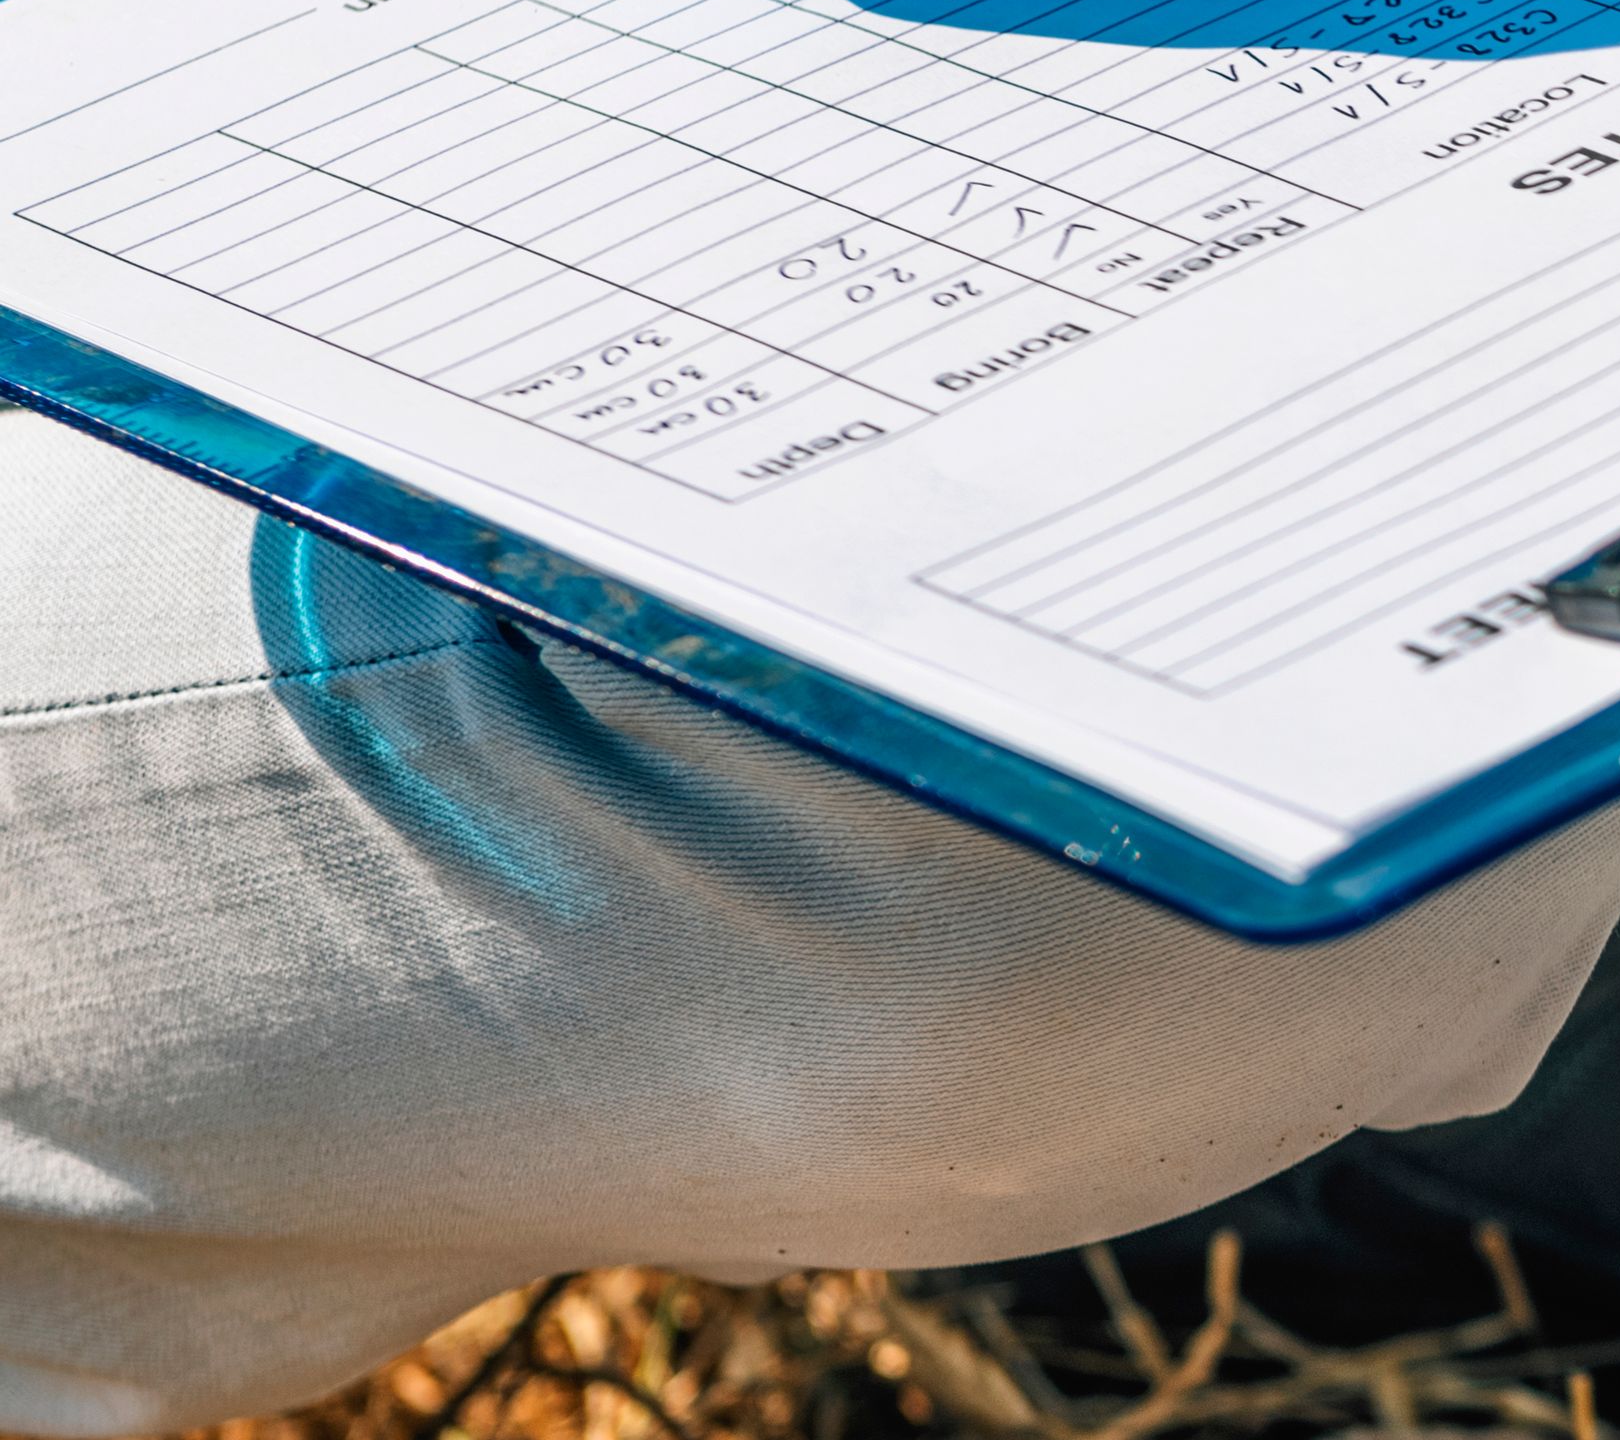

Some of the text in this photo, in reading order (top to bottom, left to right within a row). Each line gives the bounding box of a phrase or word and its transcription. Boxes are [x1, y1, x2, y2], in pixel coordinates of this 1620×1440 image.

[1420, 73, 1607, 159] Location
[1201, 196, 1262, 222] Yes
[1094, 251, 1142, 274] No
[1135, 216, 1306, 293] Repeat
[931, 321, 1090, 394] Boring
[736, 417, 884, 484] Depth
